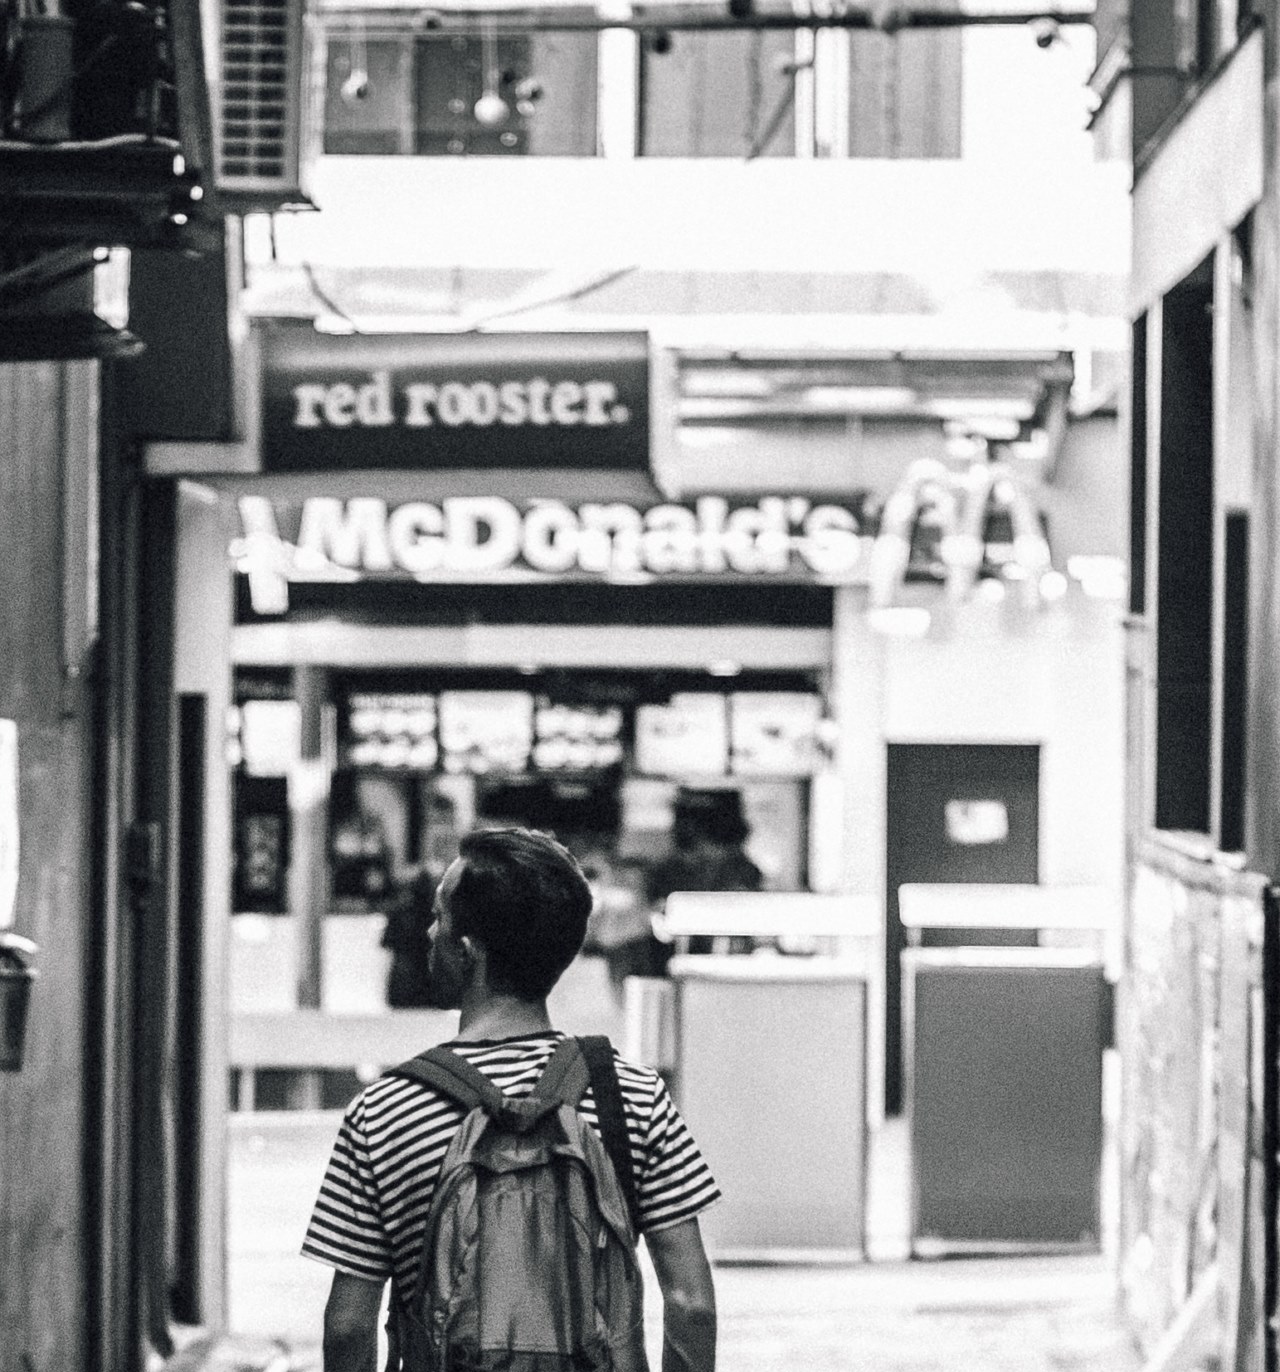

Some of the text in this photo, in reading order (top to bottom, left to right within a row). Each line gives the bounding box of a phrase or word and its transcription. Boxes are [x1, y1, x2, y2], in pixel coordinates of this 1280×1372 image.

[293, 369, 631, 428] red rooster.
[296, 496, 861, 574] McDonald's
